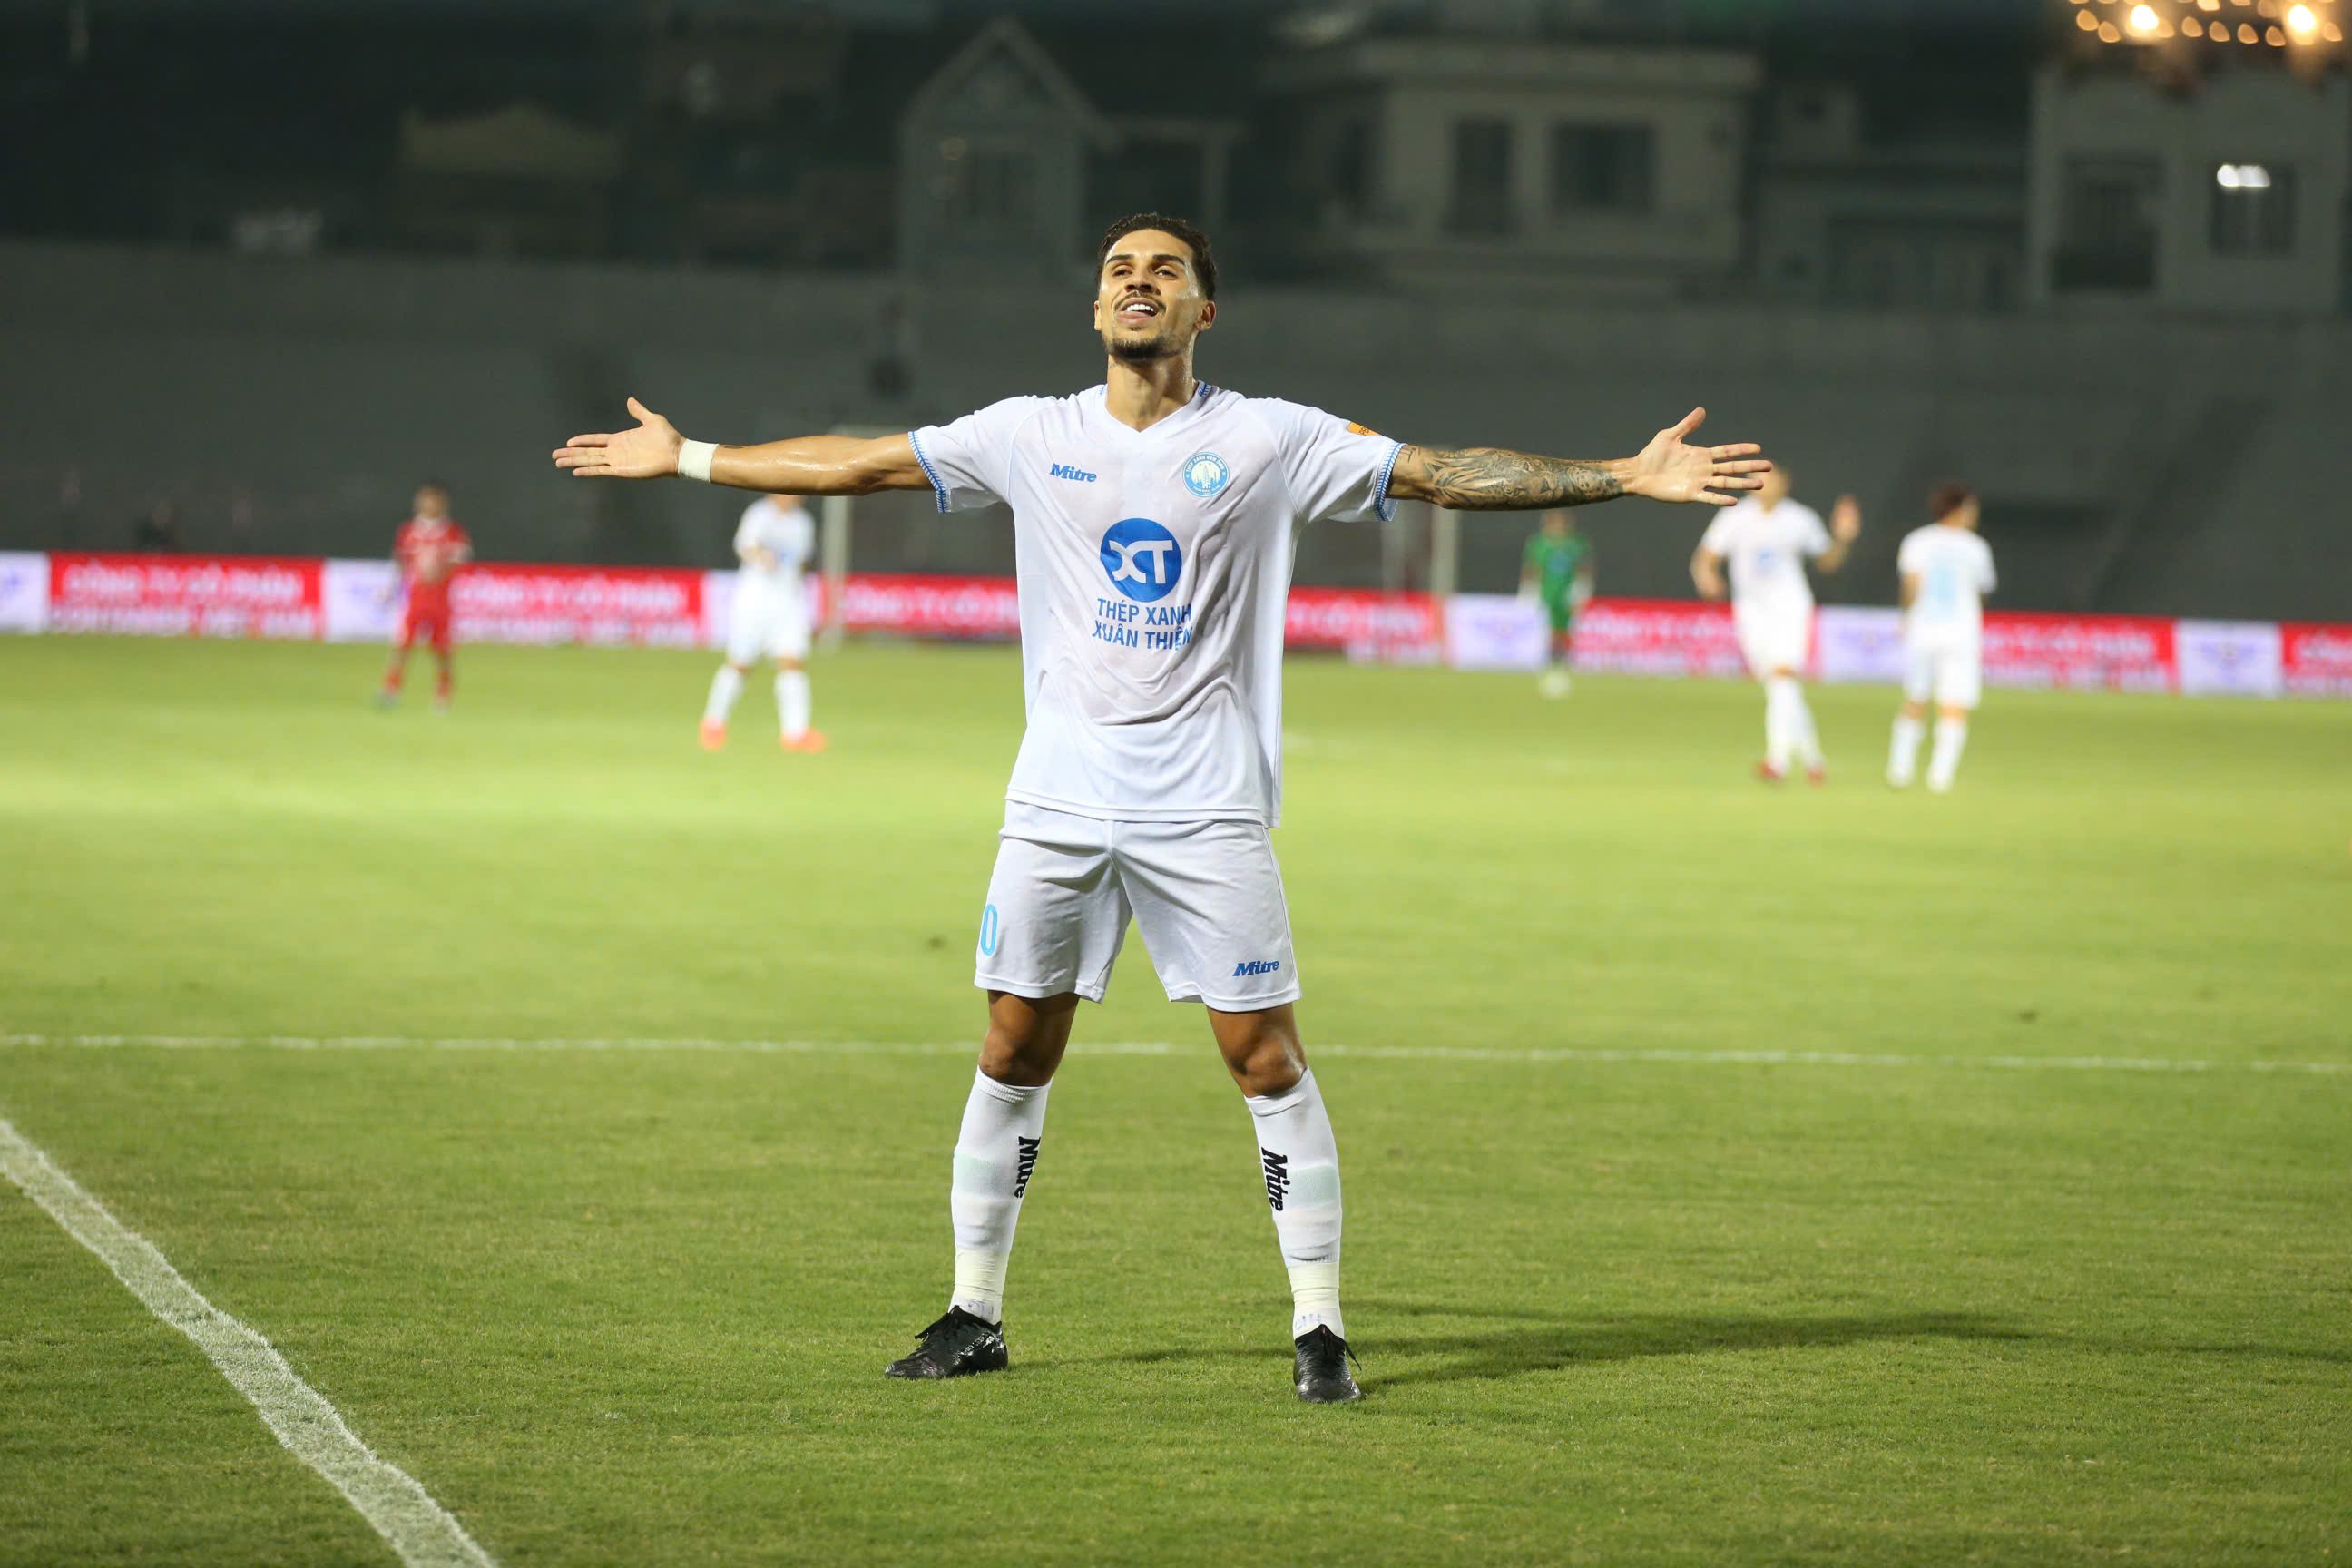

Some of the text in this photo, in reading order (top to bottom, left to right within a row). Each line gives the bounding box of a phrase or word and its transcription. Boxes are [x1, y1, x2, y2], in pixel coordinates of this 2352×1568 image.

[1049, 463, 1097, 482] Mitre
[1097, 598, 1191, 626] THÉP XANH
[1092, 620, 1139, 648] XUÂN
[1231, 959, 1280, 977] Mitre
[1261, 1146, 1291, 1212] Mitre
